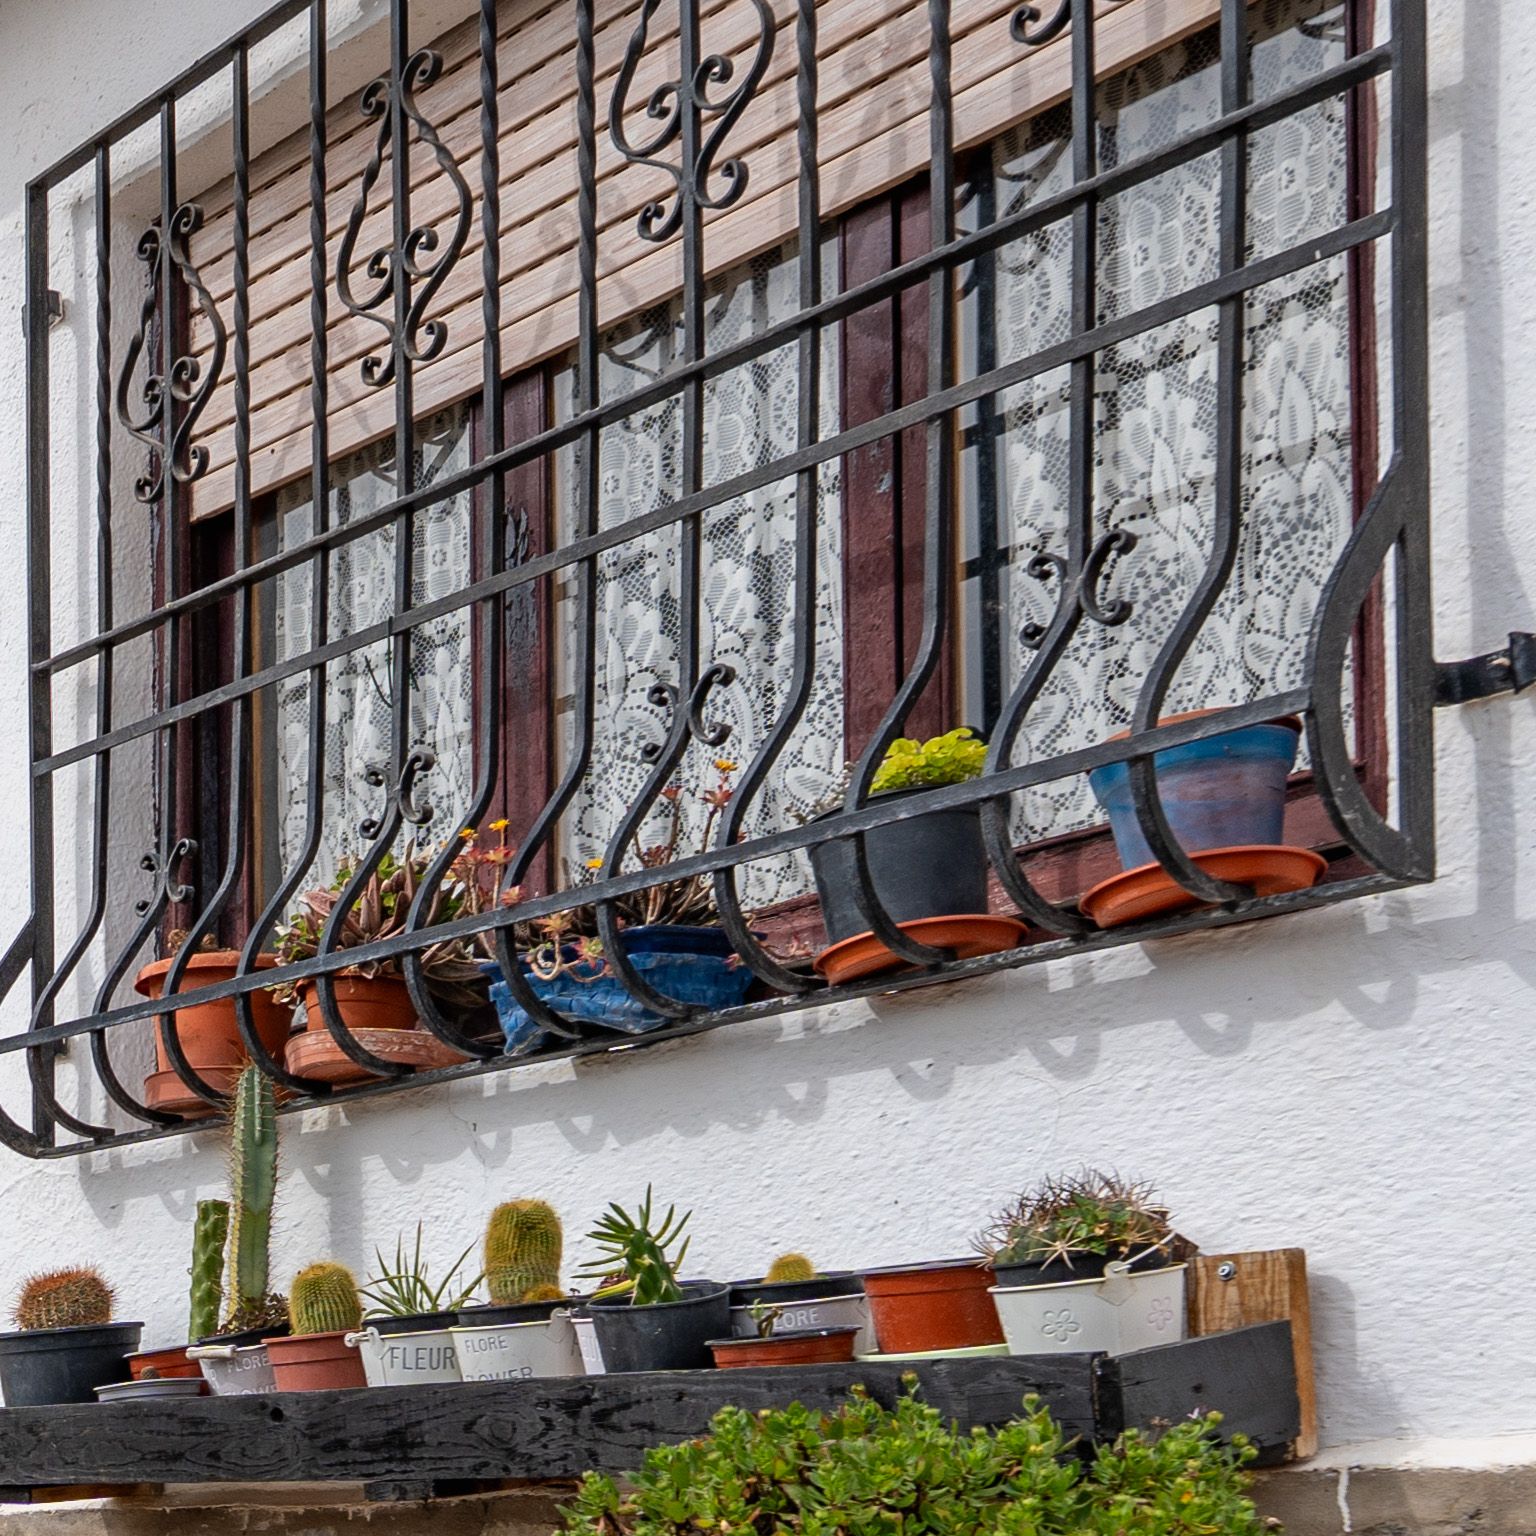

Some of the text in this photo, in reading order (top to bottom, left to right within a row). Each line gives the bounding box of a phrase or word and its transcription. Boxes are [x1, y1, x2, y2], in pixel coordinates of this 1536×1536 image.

[774, 1307, 821, 1330] LORE
[464, 1335, 509, 1354] FLORE
[227, 1352, 269, 1373] FLORE
[390, 1346, 456, 1371] FLEUR
